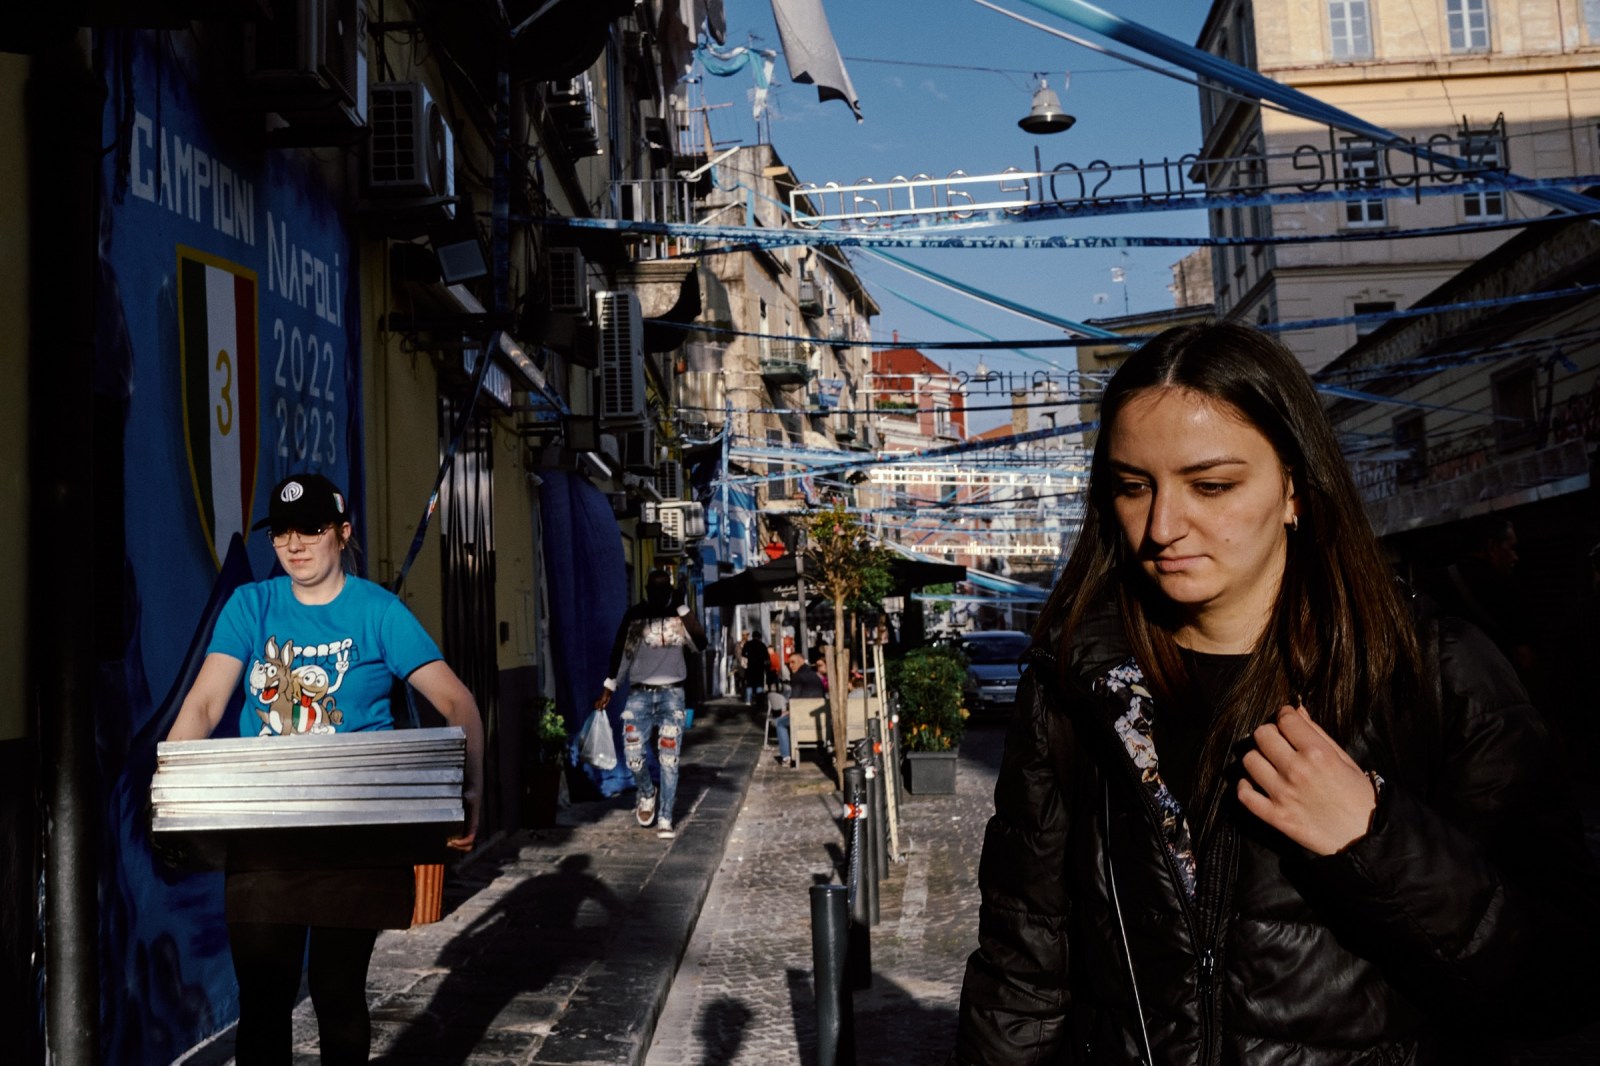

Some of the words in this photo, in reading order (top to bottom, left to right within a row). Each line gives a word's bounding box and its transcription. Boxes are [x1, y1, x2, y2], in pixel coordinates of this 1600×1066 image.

[131, 111, 255, 246] CAMPIONI
[215, 349, 233, 436] 3
[274, 318, 335, 402] 2022
[275, 397, 336, 465] 2023
